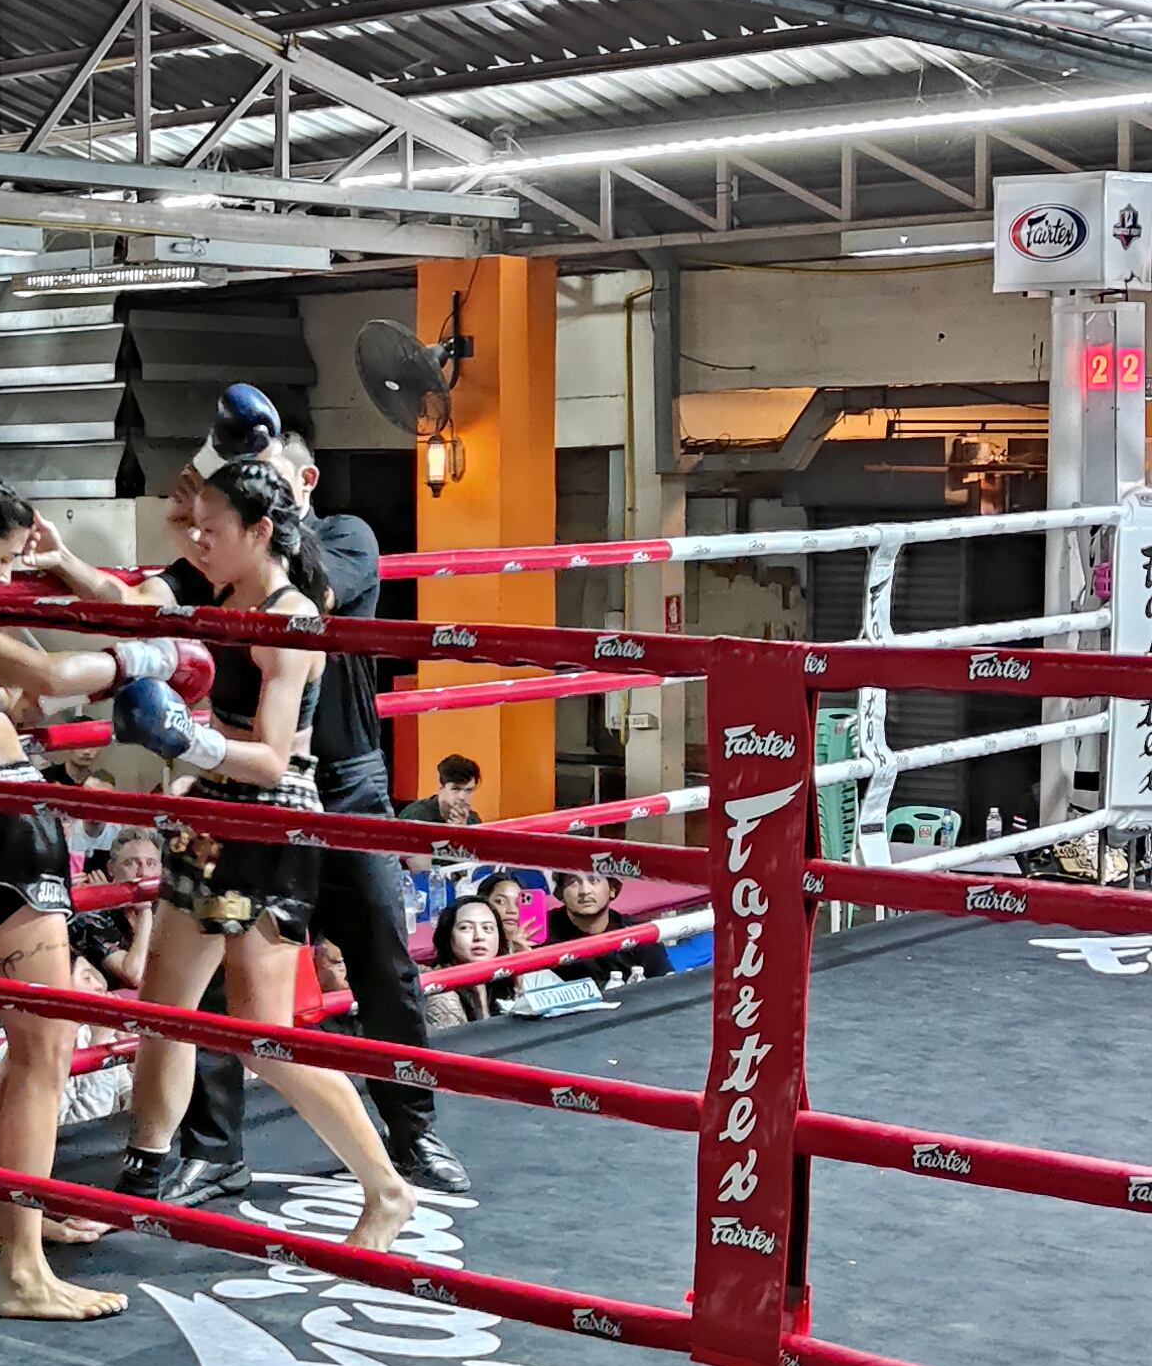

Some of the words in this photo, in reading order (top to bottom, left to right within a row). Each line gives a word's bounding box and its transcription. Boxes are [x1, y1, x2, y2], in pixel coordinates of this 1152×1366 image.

[1026, 212, 1075, 248] Fairtex
[1092, 355, 1108, 384] 2
[1123, 354, 1139, 383] 2
[594, 634, 645, 661] Fairtex
[969, 652, 1031, 681] Fairtex
[723, 723, 796, 760] Fairtex
[965, 885, 1027, 914] Fairtex
[716, 780, 804, 1203] Fairtex
[912, 1143, 971, 1174] Fairtex
[710, 1216, 776, 1255] Fairtex
